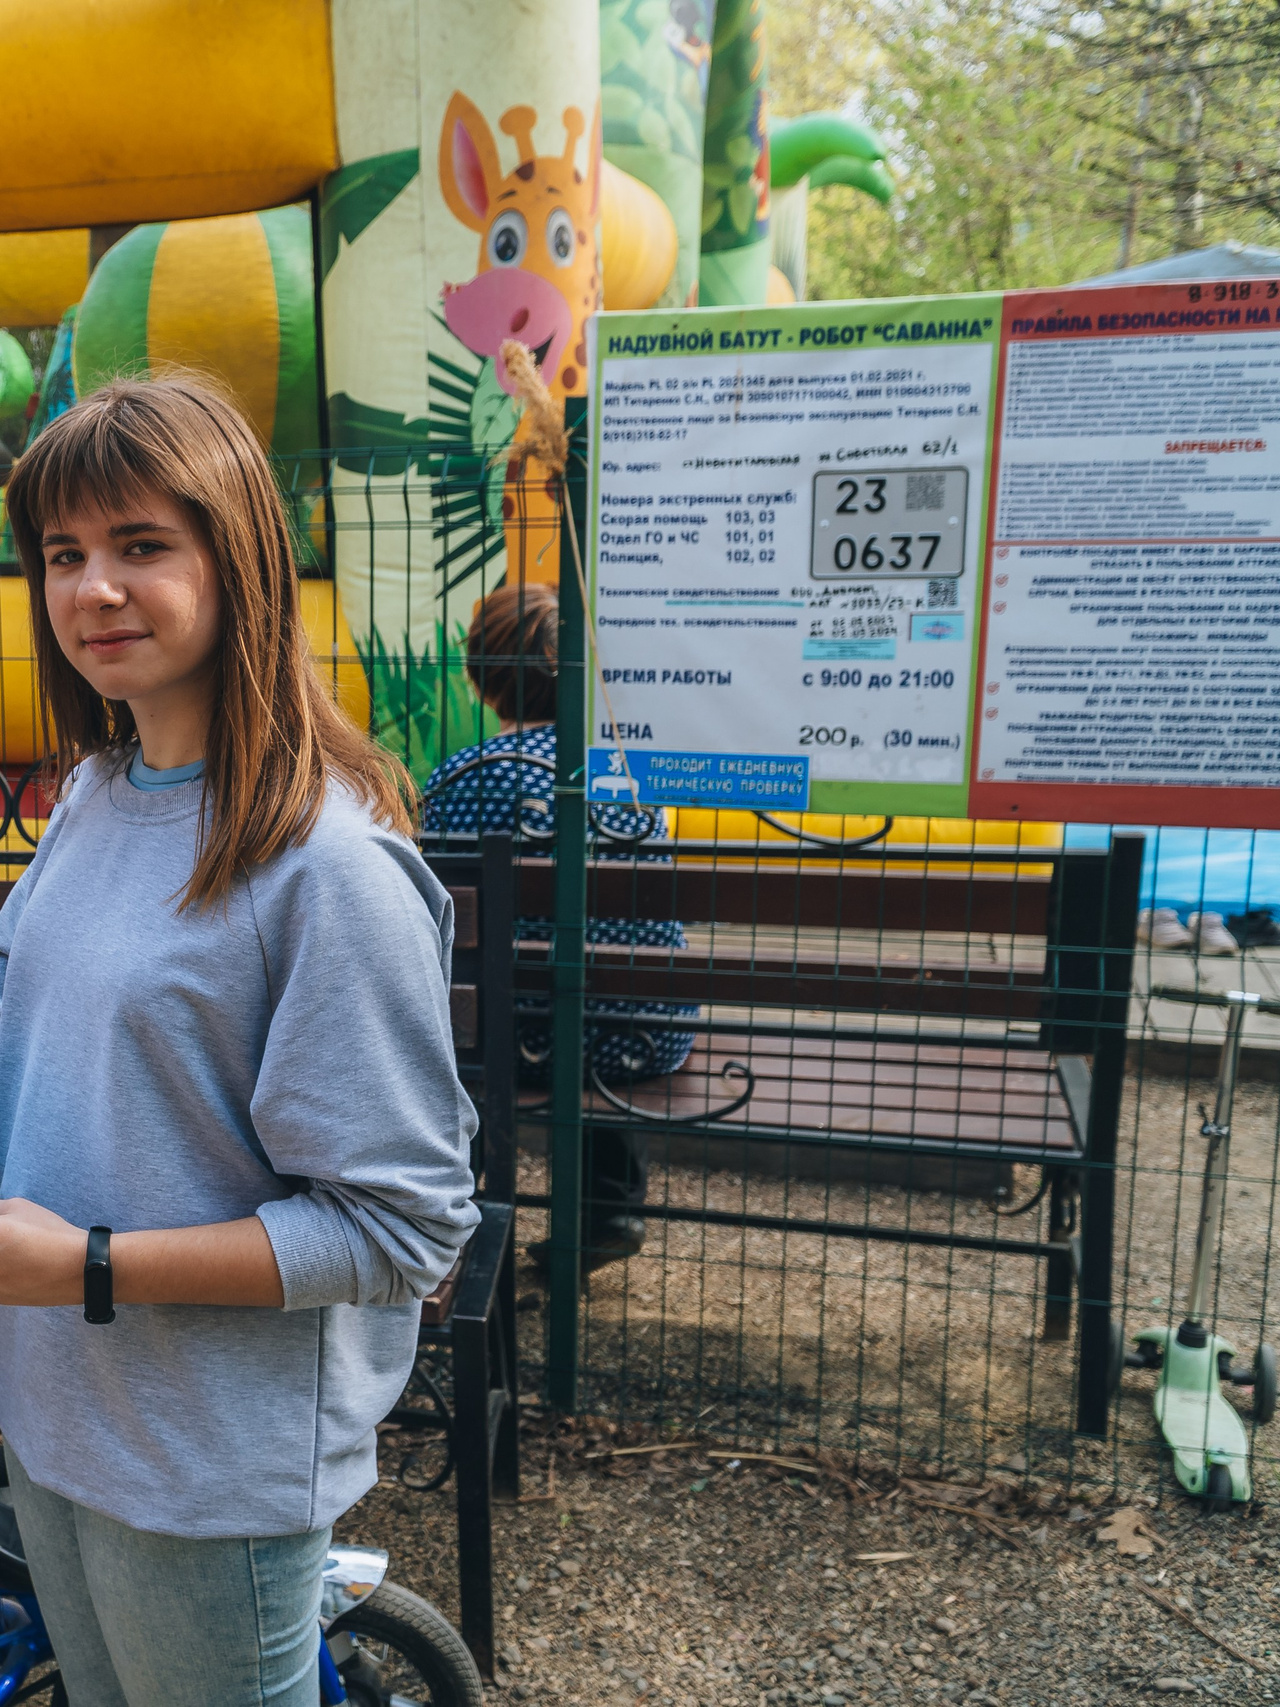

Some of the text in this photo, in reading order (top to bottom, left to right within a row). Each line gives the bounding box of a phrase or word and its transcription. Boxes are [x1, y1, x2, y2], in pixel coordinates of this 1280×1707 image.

[1011, 307, 1271, 335] ПРАВИЛА БЕЗОПАСНОСТИ НА
[608, 329, 713, 356] НАДУВНОЙ
[720, 329, 782, 349] БАТУТ
[799, 325, 868, 346] РОБОТ
[601, 493, 654, 508] Номера
[658, 492, 743, 508] экстренных
[835, 477, 888, 514] 23
[600, 513, 650, 526] Скорая
[654, 513, 708, 527] помощь
[759, 510, 776, 524] 03
[600, 531, 641, 546] Отдел
[645, 530, 663, 544] ГО
[680, 530, 700, 544] ЧС
[758, 530, 775, 544] 01
[759, 549, 776, 564] 02
[834, 532, 942, 571] 0637
[601, 668, 657, 685] ВРЕМЯ
[661, 668, 732, 685] РАБОТЫ
[820, 669, 862, 688] 9:00
[868, 673, 892, 690] до
[899, 669, 955, 688] 21:00
[600, 722, 654, 741] ЦЕНА
[798, 725, 847, 747] 200
[650, 755, 805, 777] ПРОХОДИТ ЕЖЕДНЕВНУЮ
[647, 775, 804, 797] ТЕХНИЧЕСКУЮ ПРОВЕРКУ
